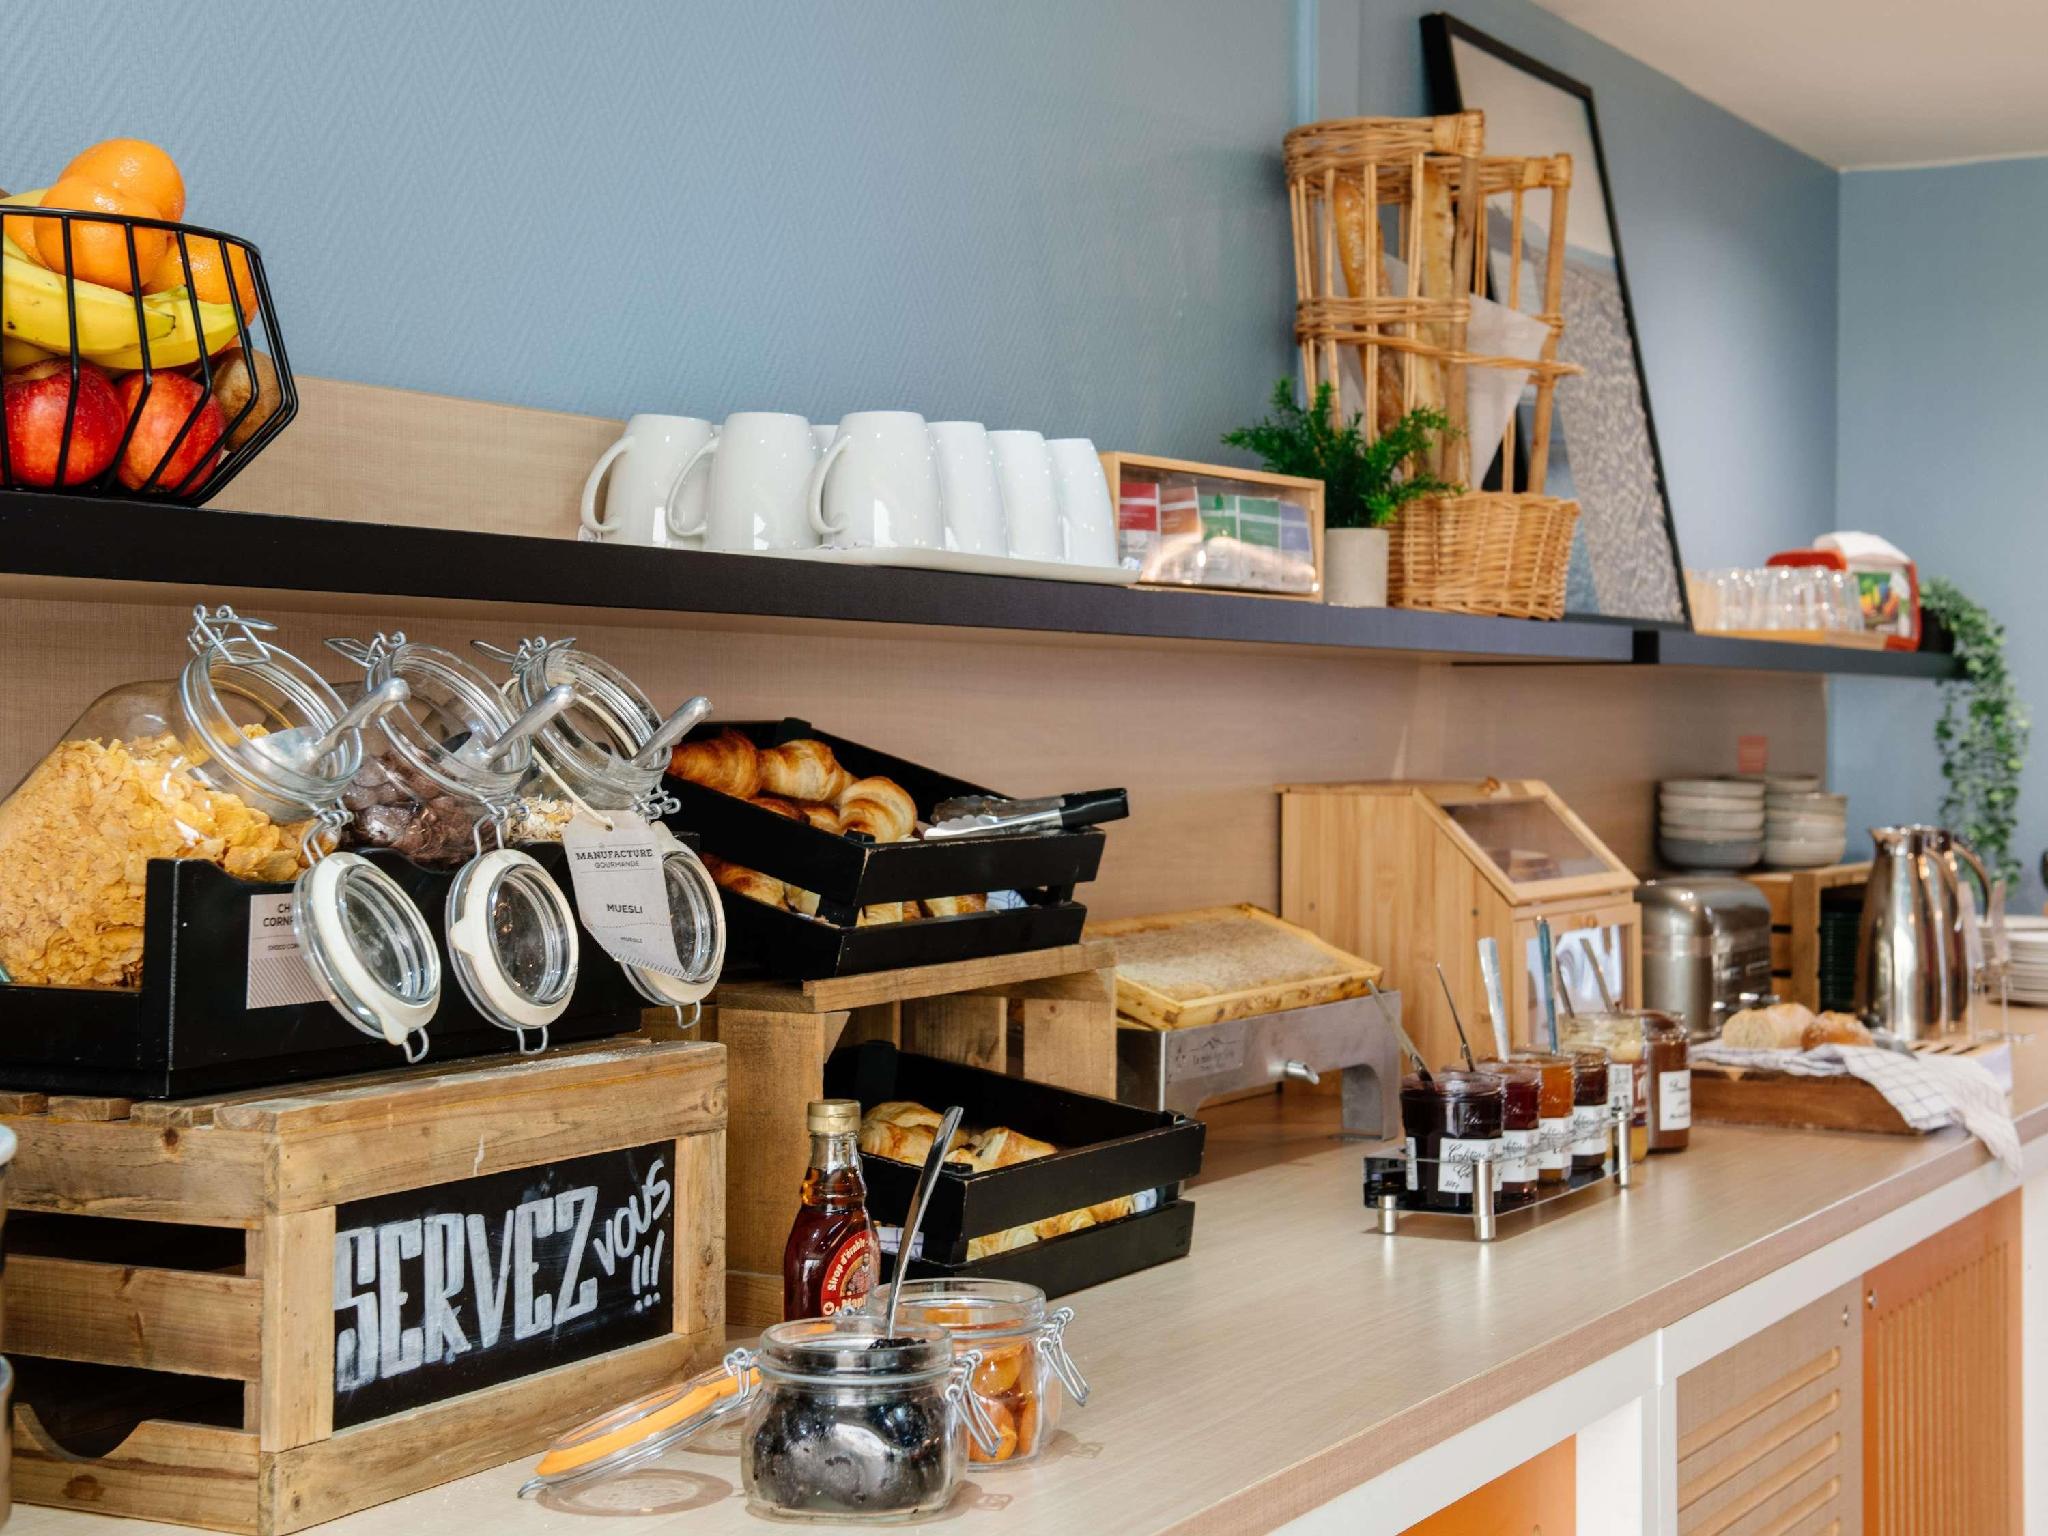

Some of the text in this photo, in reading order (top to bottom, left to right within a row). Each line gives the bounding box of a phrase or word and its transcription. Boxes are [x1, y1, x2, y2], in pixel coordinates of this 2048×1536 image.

[576, 849, 654, 861] MANUFACTURE
[594, 861, 640, 869] GOURMANDE
[606, 903, 644, 914] MUESLI
[333, 1159, 671, 1393] SERVEZ VOUS
[827, 1264, 843, 1291] Sirop
